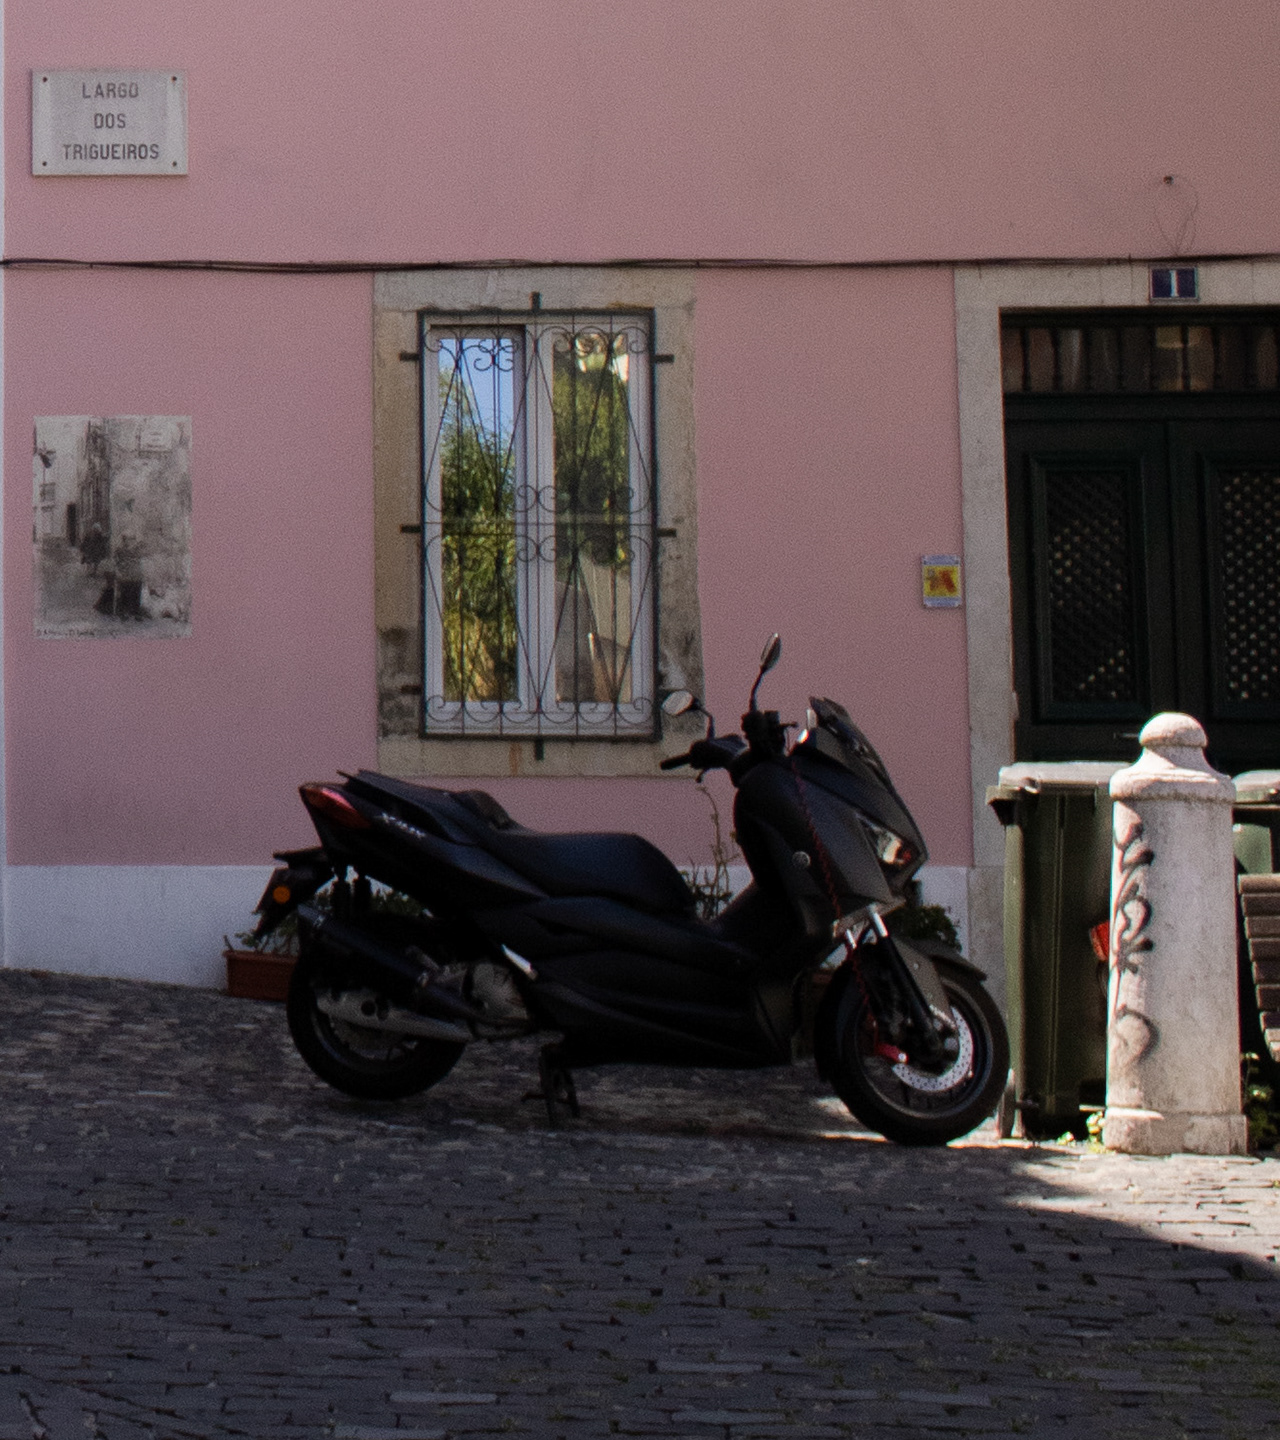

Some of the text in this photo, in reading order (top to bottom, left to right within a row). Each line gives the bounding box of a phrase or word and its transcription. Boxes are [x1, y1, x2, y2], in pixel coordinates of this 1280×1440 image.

[82, 82, 140, 99] LARGO
[93, 113, 126, 129] DOS
[62, 144, 159, 160] TRIGUEIROS
[1168, 269, 1180, 297] 1
